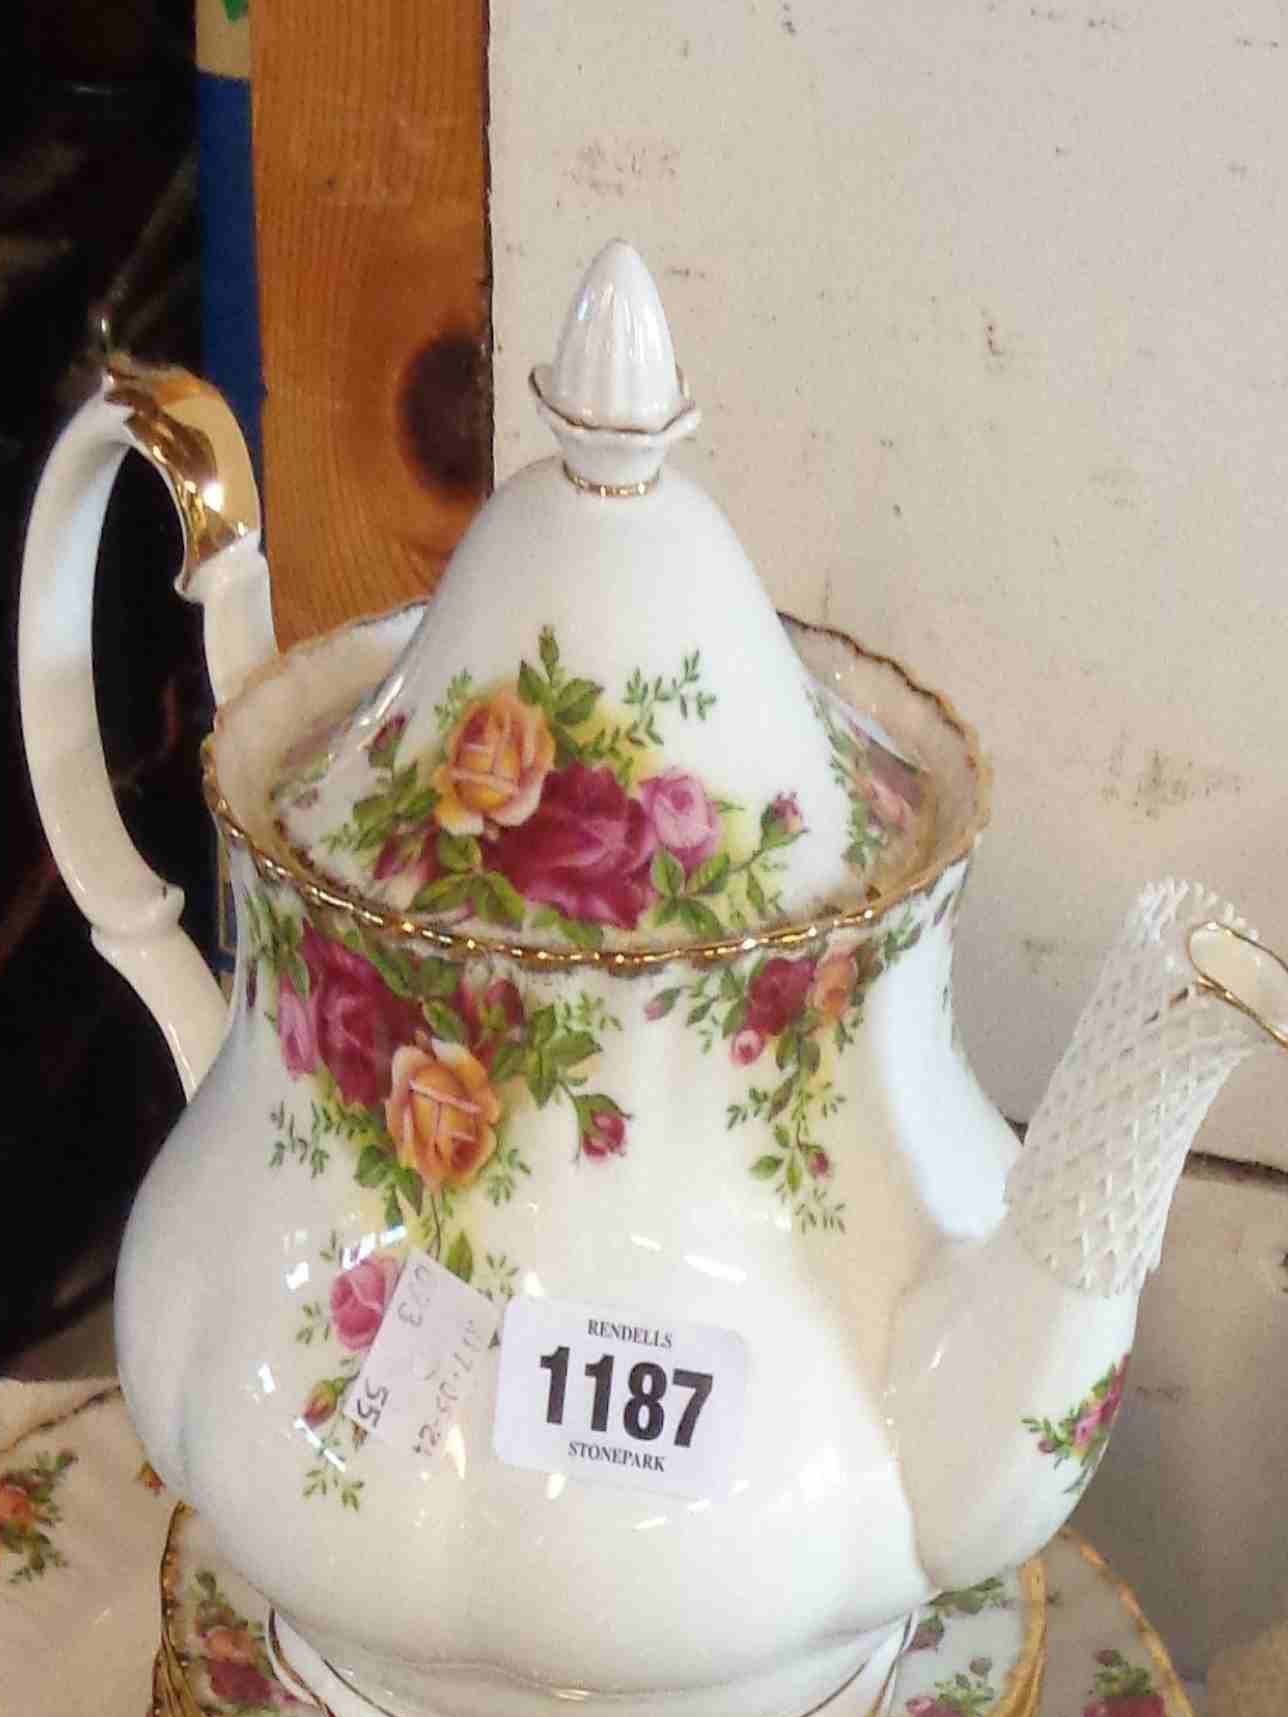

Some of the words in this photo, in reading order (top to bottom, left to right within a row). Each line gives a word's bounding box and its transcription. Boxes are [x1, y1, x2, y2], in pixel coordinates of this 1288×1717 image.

[588, 1319, 673, 1348] RENDELLS
[356, 1378, 390, 1428] 55
[540, 1346, 714, 1448] 1187
[568, 1441, 666, 1472] STONEPARK
